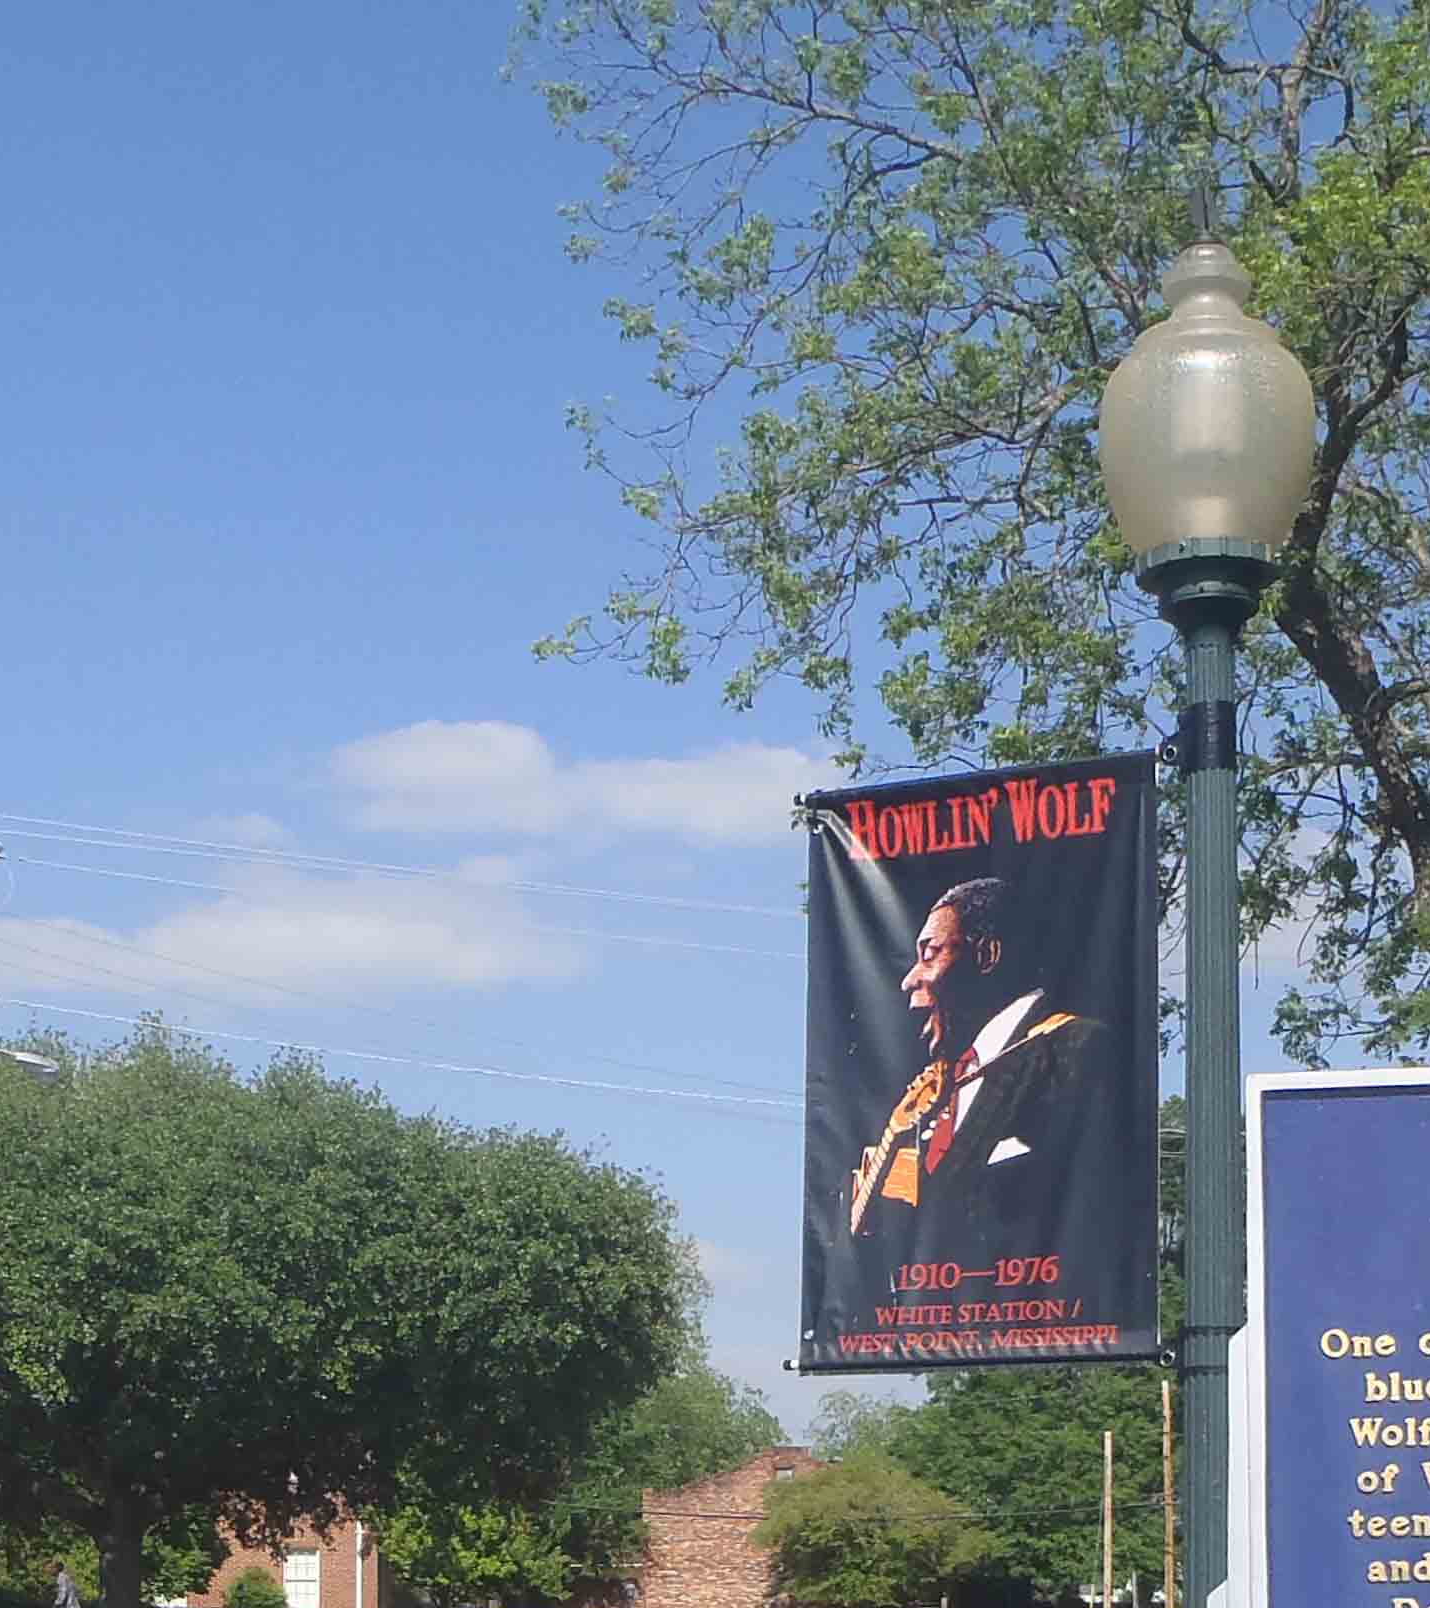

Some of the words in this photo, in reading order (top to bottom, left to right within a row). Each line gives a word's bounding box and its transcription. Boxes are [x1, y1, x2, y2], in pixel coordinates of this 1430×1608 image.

[847, 787, 999, 861] HOWLIN’
[1005, 777, 1116, 842] WOLF
[875, 1304, 953, 1327] WHITE
[960, 1300, 1065, 1325] STATION
[1072, 1298, 1082, 1320] /
[839, 1333, 897, 1353] WEST
[903, 1330, 981, 1351] POINT,
[991, 1325, 1118, 1348] MISSISSIPPI
[1323, 1328, 1399, 1361] One
[1359, 1463, 1404, 1496] of
